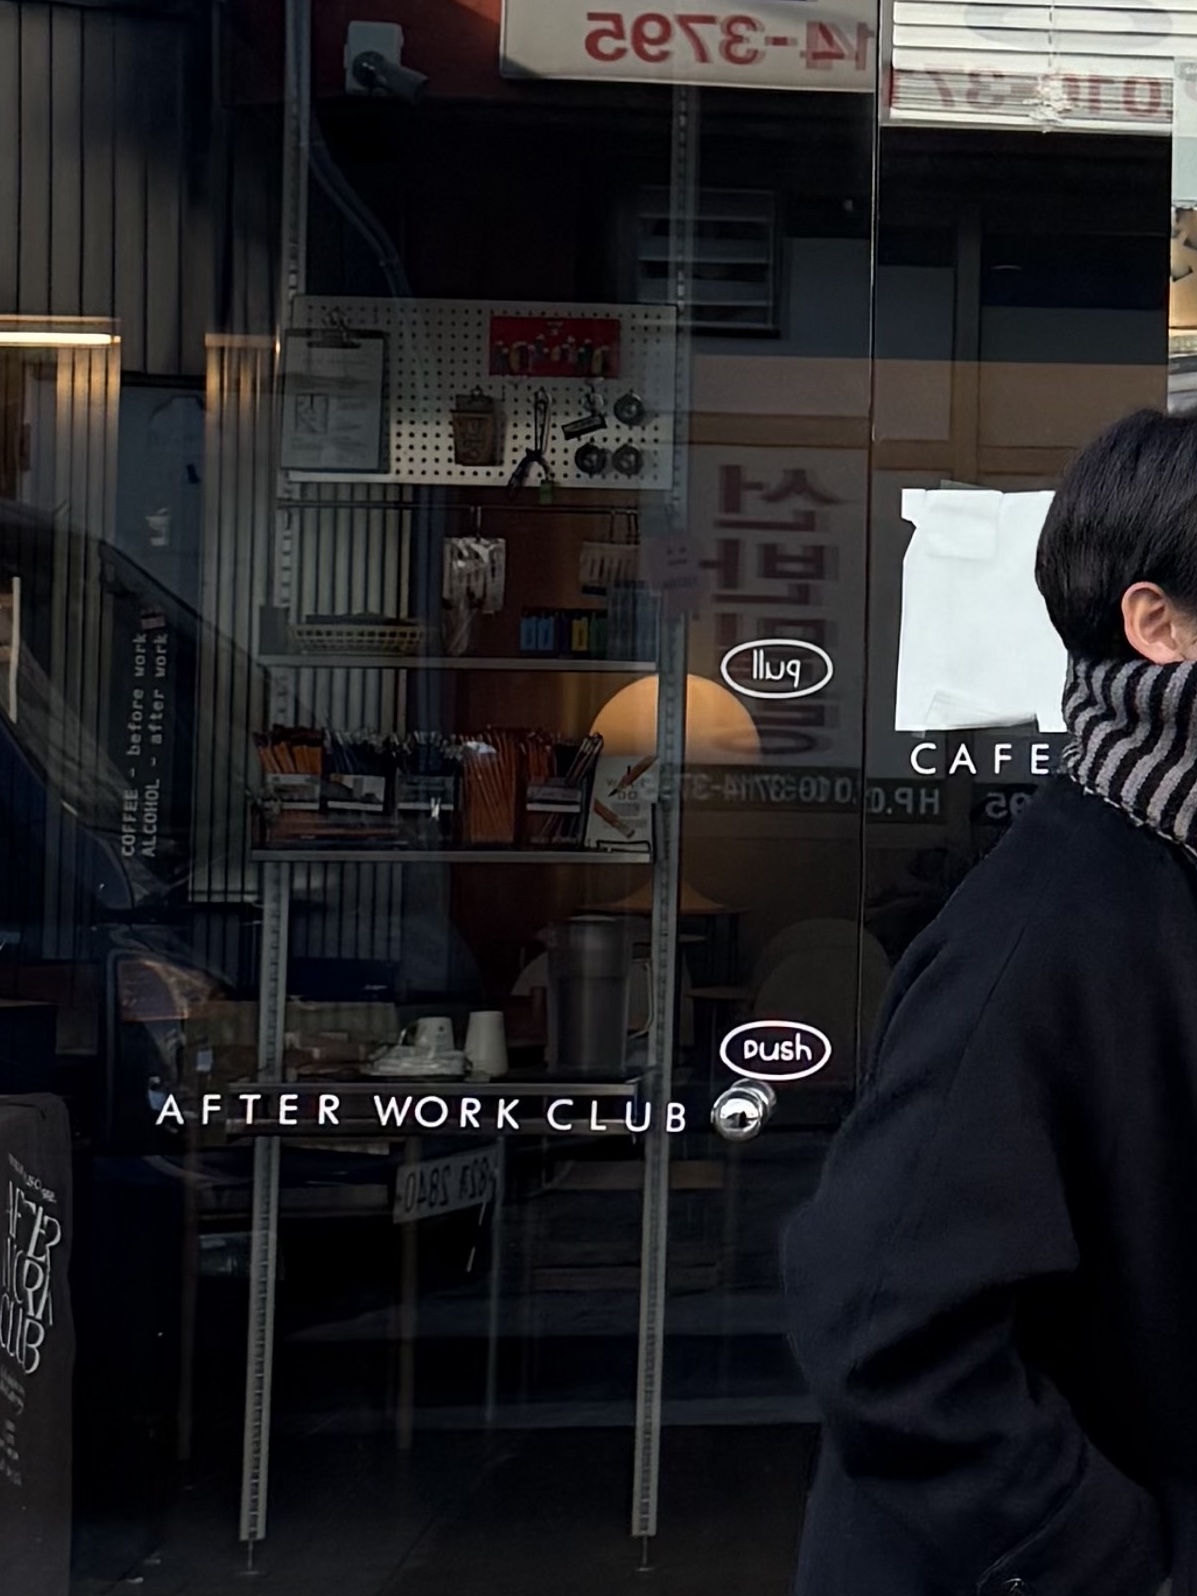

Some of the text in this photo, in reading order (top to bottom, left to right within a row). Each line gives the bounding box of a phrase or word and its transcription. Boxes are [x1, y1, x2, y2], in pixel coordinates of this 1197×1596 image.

[121, 633, 147, 857] COFFEE before work
[142, 633, 169, 858] ALCOHOL after work
[910, 742, 1050, 775] CAFE
[155, 1093, 687, 1134] AFTER WORK CLUB
